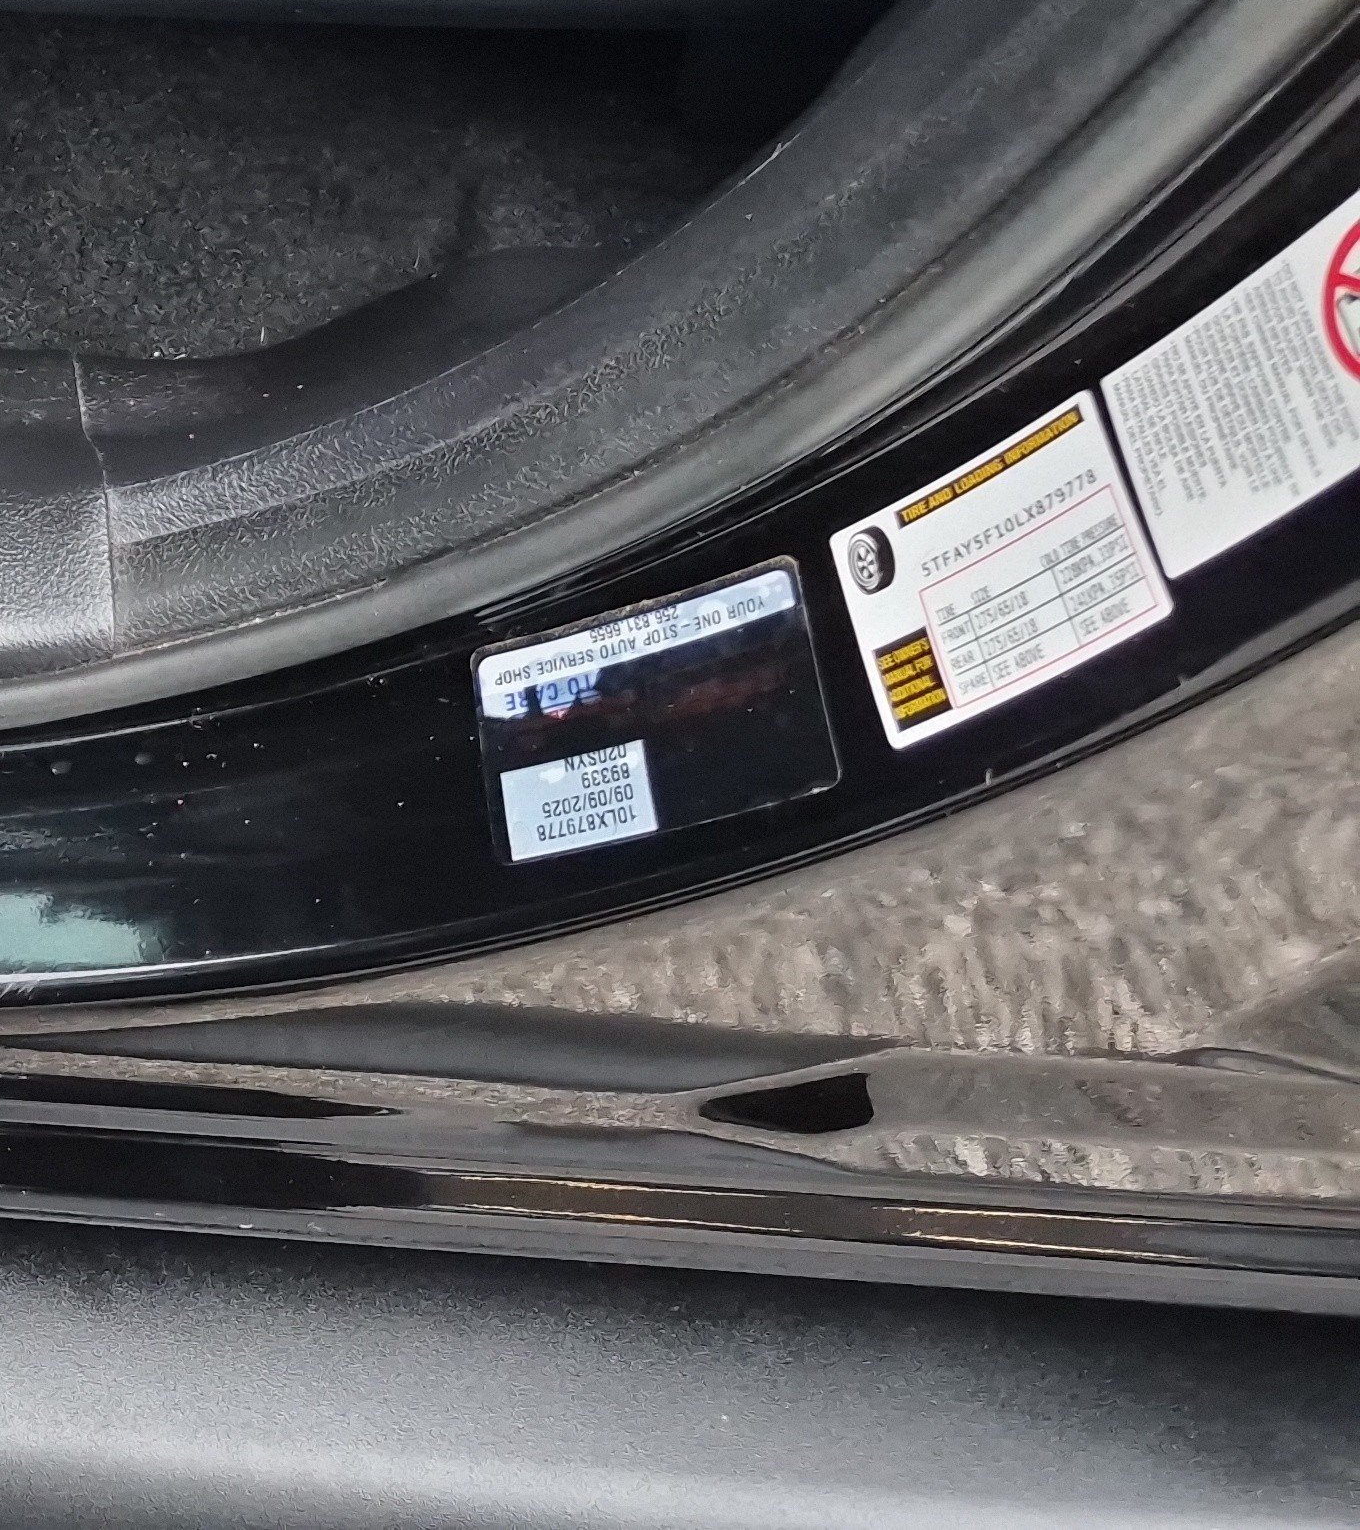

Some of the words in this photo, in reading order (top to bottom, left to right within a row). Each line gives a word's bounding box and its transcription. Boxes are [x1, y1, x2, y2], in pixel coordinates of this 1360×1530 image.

[900, 500, 928, 522] TIRE
[926, 486, 953, 509] AND
[952, 456, 1003, 494] LOADING
[1003, 410, 1079, 464] INFORMATION
[725, 595, 764, 618] YOUR
[588, 604, 678, 642] 256.831.6655
[598, 635, 637, 658] AUTO
[493, 664, 531, 686] SHOP
[535, 647, 593, 676] SERVICE
[579, 762, 630, 788] 89339
[540, 782, 634, 818] 09/09/2025
[536, 803, 637, 841] 10LX879778
